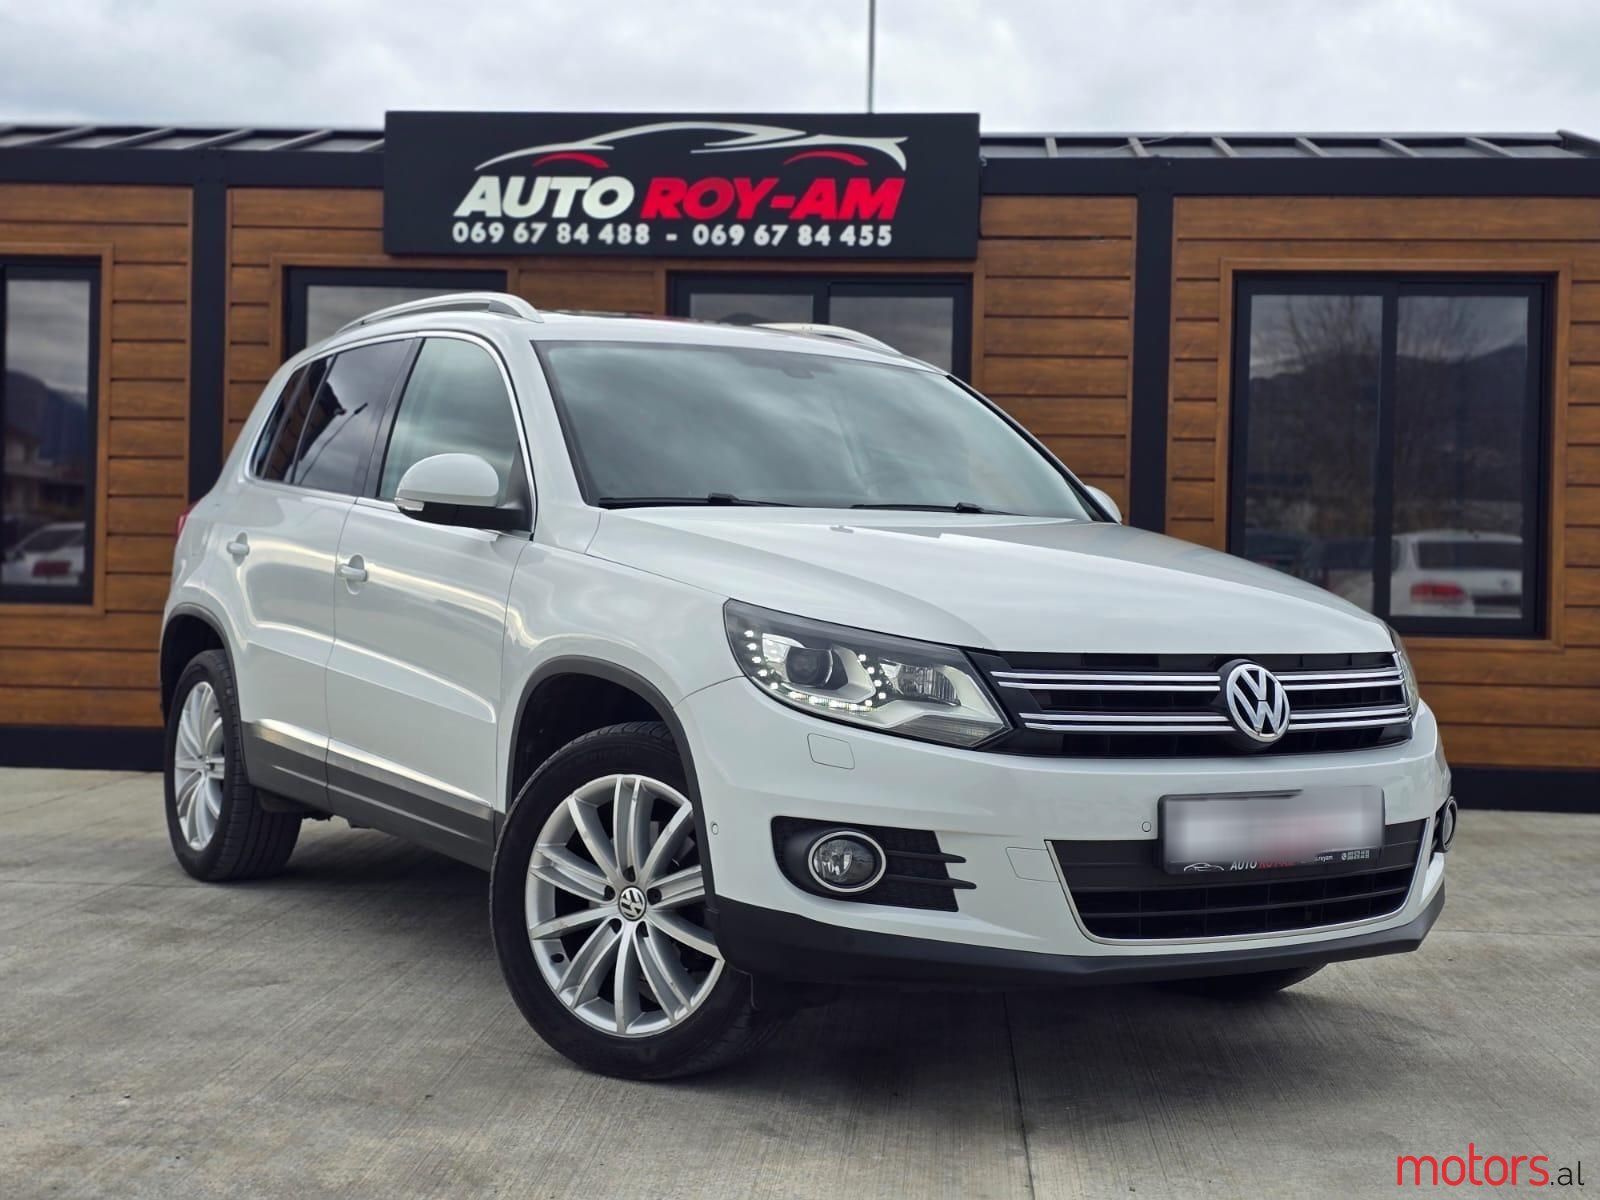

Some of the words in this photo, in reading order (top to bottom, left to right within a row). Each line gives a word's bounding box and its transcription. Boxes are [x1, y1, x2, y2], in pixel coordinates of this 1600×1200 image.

[453, 175, 635, 219] AUTO
[640, 176, 906, 221] ROY-AM
[452, 221, 505, 243] 069
[513, 222, 548, 244] 67
[556, 222, 590, 245] 84
[598, 223, 650, 245] 488
[692, 223, 745, 246] 069
[753, 224, 789, 247] 67
[797, 224, 831, 247] 84
[839, 224, 892, 247] 455
